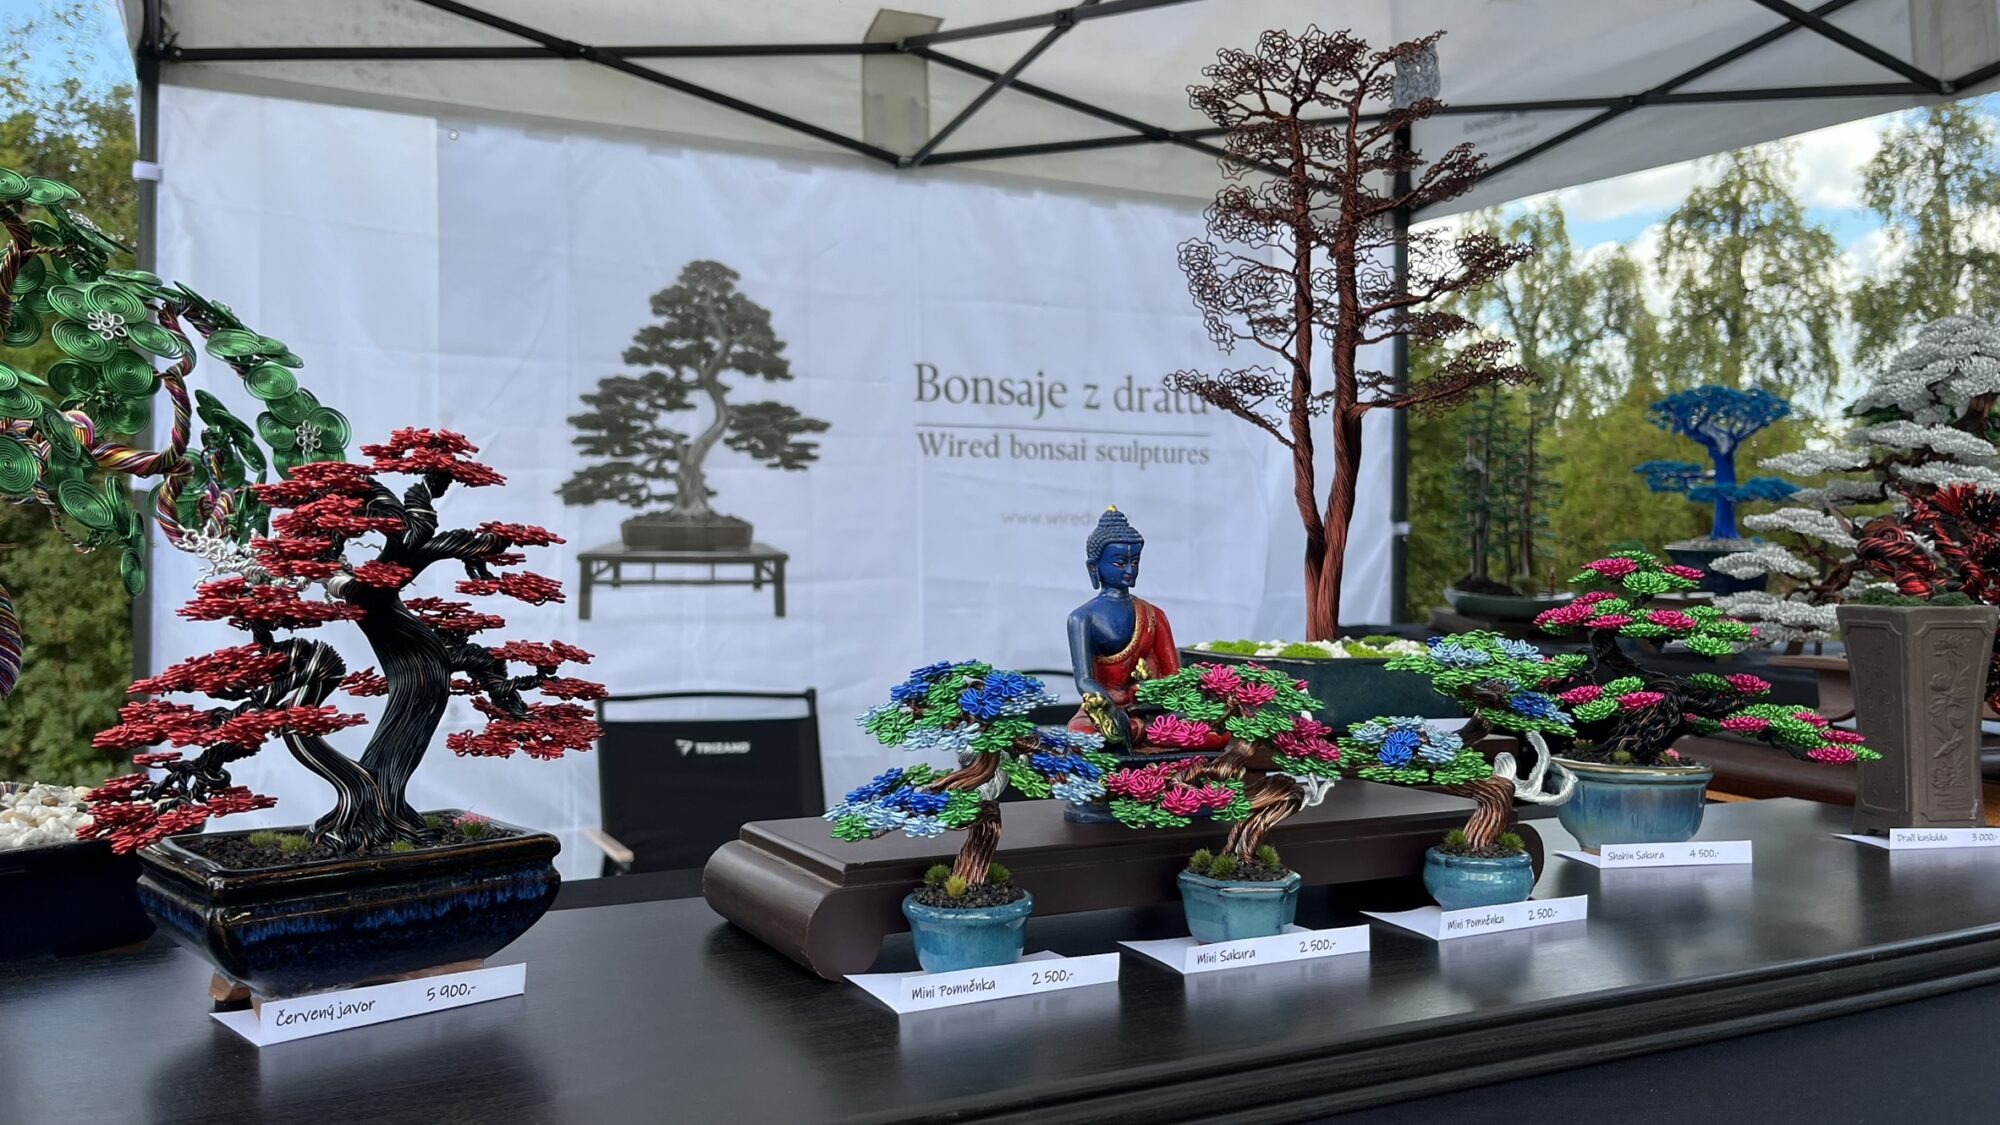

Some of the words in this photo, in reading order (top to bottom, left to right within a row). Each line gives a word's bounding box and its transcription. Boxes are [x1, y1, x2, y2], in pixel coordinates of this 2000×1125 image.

[914, 363, 1067, 420] Bonsaje
[1083, 383, 1101, 410] z
[917, 432, 1000, 458] Wired
[1009, 433, 1087, 462] bonsai
[1095, 440, 1210, 470] sculptures
[1972, 833, 1978, 842] 3
[1636, 850, 1665, 861] Sakura
[1689, 848, 1696, 858] 4
[1447, 920, 1464, 931] Mini
[1528, 910, 1535, 921] 2
[1537, 907, 1559, 920] 500,-
[1196, 953, 1217, 965] Mini
[1219, 949, 1256, 963] Sakura
[1299, 941, 1308, 953] 2
[1310, 939, 1337, 951] 500,-
[911, 986, 935, 1000] Mini
[938, 977, 996, 997] Pomněnka
[1031, 972, 1041, 986] 2
[1044, 969, 1075, 984] 500,-
[275, 1003, 336, 1028] Červený
[337, 999, 376, 1020] javor
[426, 987, 436, 1002] 5
[439, 983, 477, 999] 900,-
